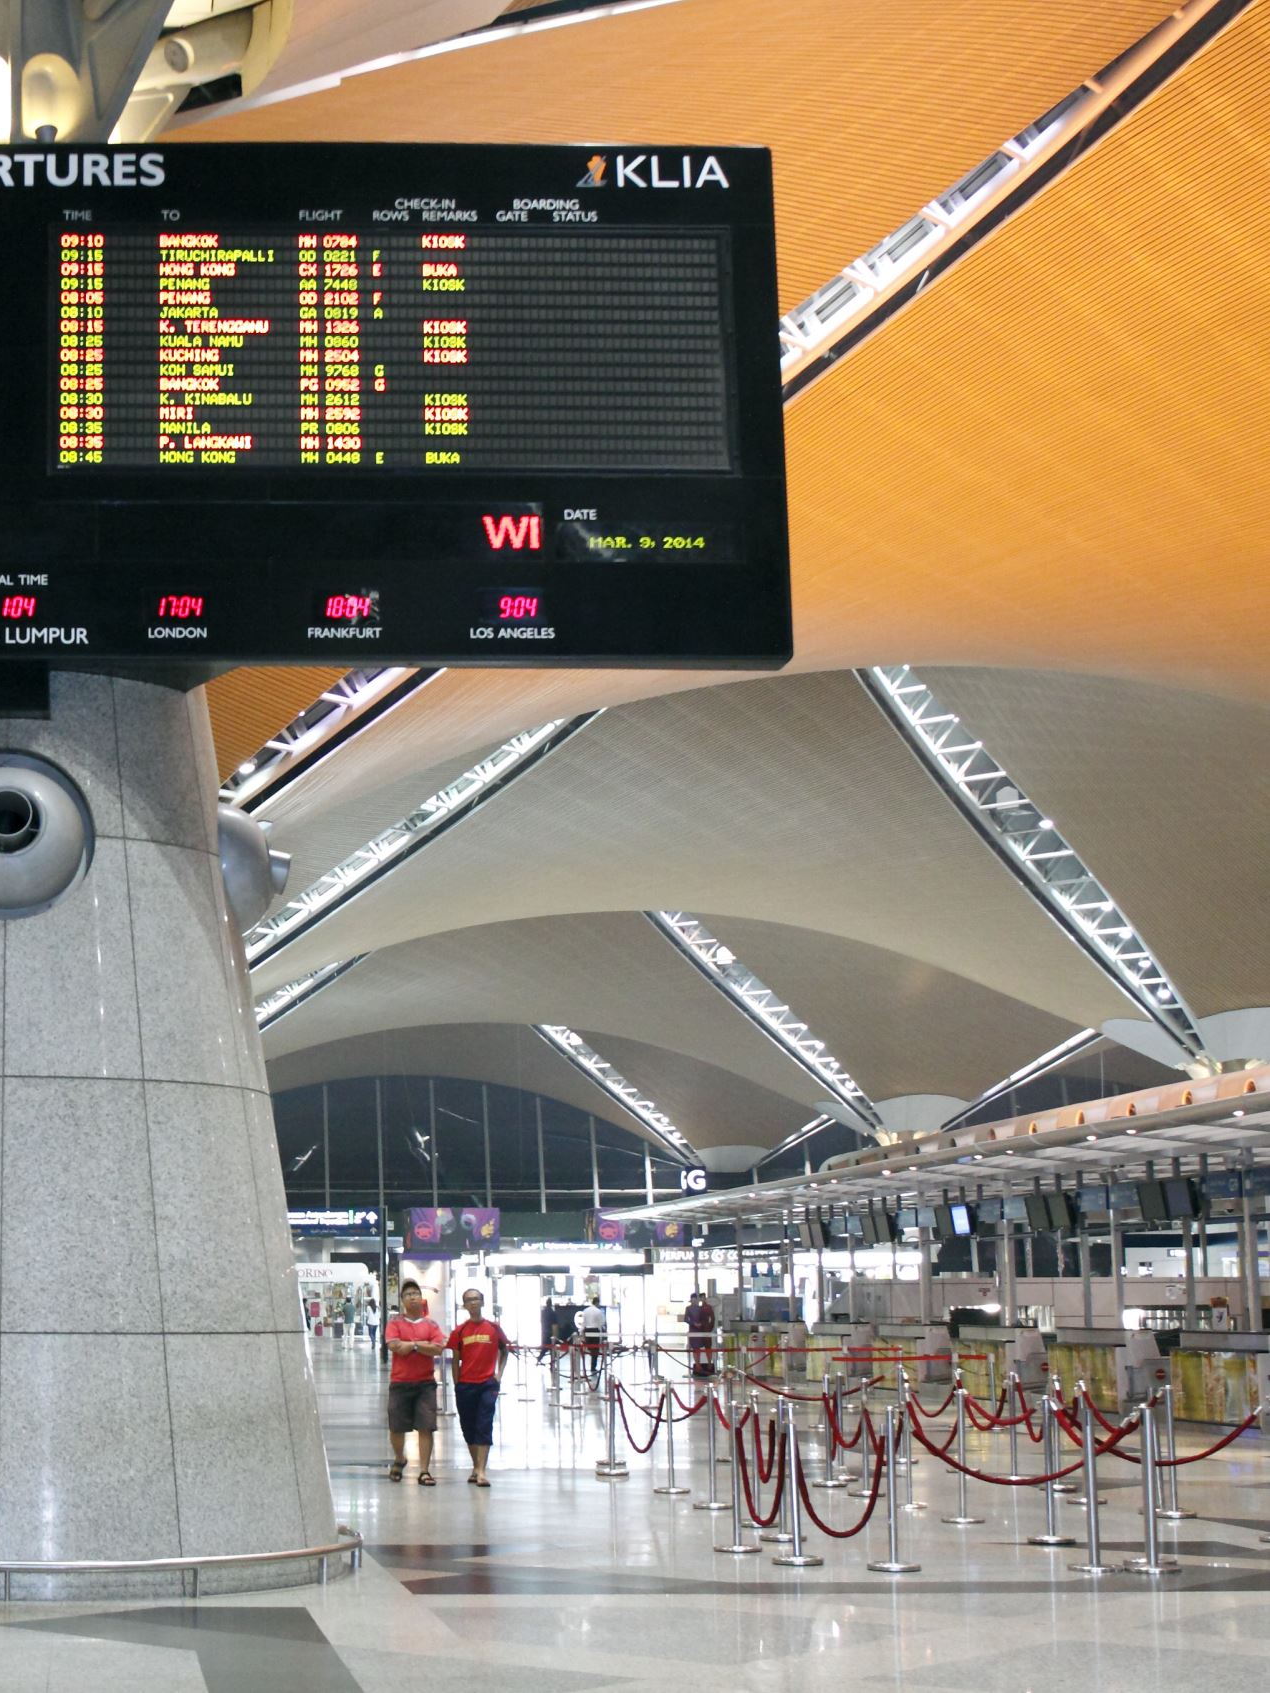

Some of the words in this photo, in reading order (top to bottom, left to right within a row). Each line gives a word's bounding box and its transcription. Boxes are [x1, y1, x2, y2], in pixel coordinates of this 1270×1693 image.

[617, 155, 729, 188] KLIA
[395, 199, 455, 209] CHECK-IN
[513, 199, 579, 210] BOARDING
[63, 210, 91, 220] TIME
[162, 210, 180, 221] TO
[299, 210, 342, 221] FLIGHT
[373, 211, 412, 221] ROWS
[422, 211, 477, 221] REMARKS
[496, 211, 528, 221] GATE
[553, 211, 597, 222] STATUS
[61, 234, 104, 248] 09:10
[159, 234, 218, 248] BANGKOK
[422, 235, 466, 249] KIOSK
[62, 249, 102, 262] 09:15
[161, 249, 274, 262] TIRUCHIRAPALLI
[61, 263, 104, 277] 09:15
[159, 263, 194, 277] HONG
[198, 263, 236, 277] KONG
[423, 264, 458, 278] BUKA
[61, 278, 103, 291] 09:15
[160, 278, 210, 291] PENANG
[423, 279, 464, 291] KIOSK
[61, 292, 104, 306] 08:05
[159, 292, 212, 306] PENANG
[61, 307, 103, 319] 08:10
[160, 307, 218, 319] JAKARTA
[60, 320, 104, 334] 08:15
[159, 320, 175, 334] K.
[184, 321, 270, 335] TERENGGANU
[424, 321, 468, 335] KIOSK
[61, 336, 103, 348] 08:25
[160, 336, 202, 348] KUALA
[209, 336, 243, 348] NAMU
[424, 336, 466, 349] KIOSK
[60, 349, 104, 363] 08:25
[159, 349, 220, 363] KUCHING
[424, 350, 468, 364] KIOSK
[61, 364, 102, 377] 08:25
[160, 364, 185, 377] KOH
[193, 364, 233, 377] SAMUI
[60, 378, 104, 392] 08:25
[159, 378, 220, 392] BANGKOK
[60, 393, 103, 406] 08:30
[160, 393, 174, 406] K.
[185, 393, 252, 406] KINABALU
[425, 394, 467, 406] KIOSK
[60, 407, 103, 421] 08:30
[159, 407, 194, 421] MIRI
[425, 407, 469, 421] KIOSK
[60, 422, 102, 435] 08:35
[160, 422, 211, 435] MANILA
[425, 422, 467, 435] KIOSK
[159, 436, 176, 450] P.
[184, 436, 253, 450] LANGKAWI
[160, 451, 194, 463] HONG
[201, 451, 235, 463] KONG
[426, 451, 460, 464] BUKA
[564, 509, 596, 520] DATE
[482, 516, 541, 550] WI
[590, 535, 631, 549] MAR.
[640, 537, 655, 548] 9,
[664, 537, 704, 548] 2014
[18, 574, 47, 585] TIME
[6, 628, 88, 644] LUMPUR
[148, 627, 207, 638] LONDON
[308, 627, 382, 638] FRANKFURT
[470, 628, 494, 638] LOS
[498, 628, 555, 638] ANGELES
[687, 1169, 706, 1190] G
